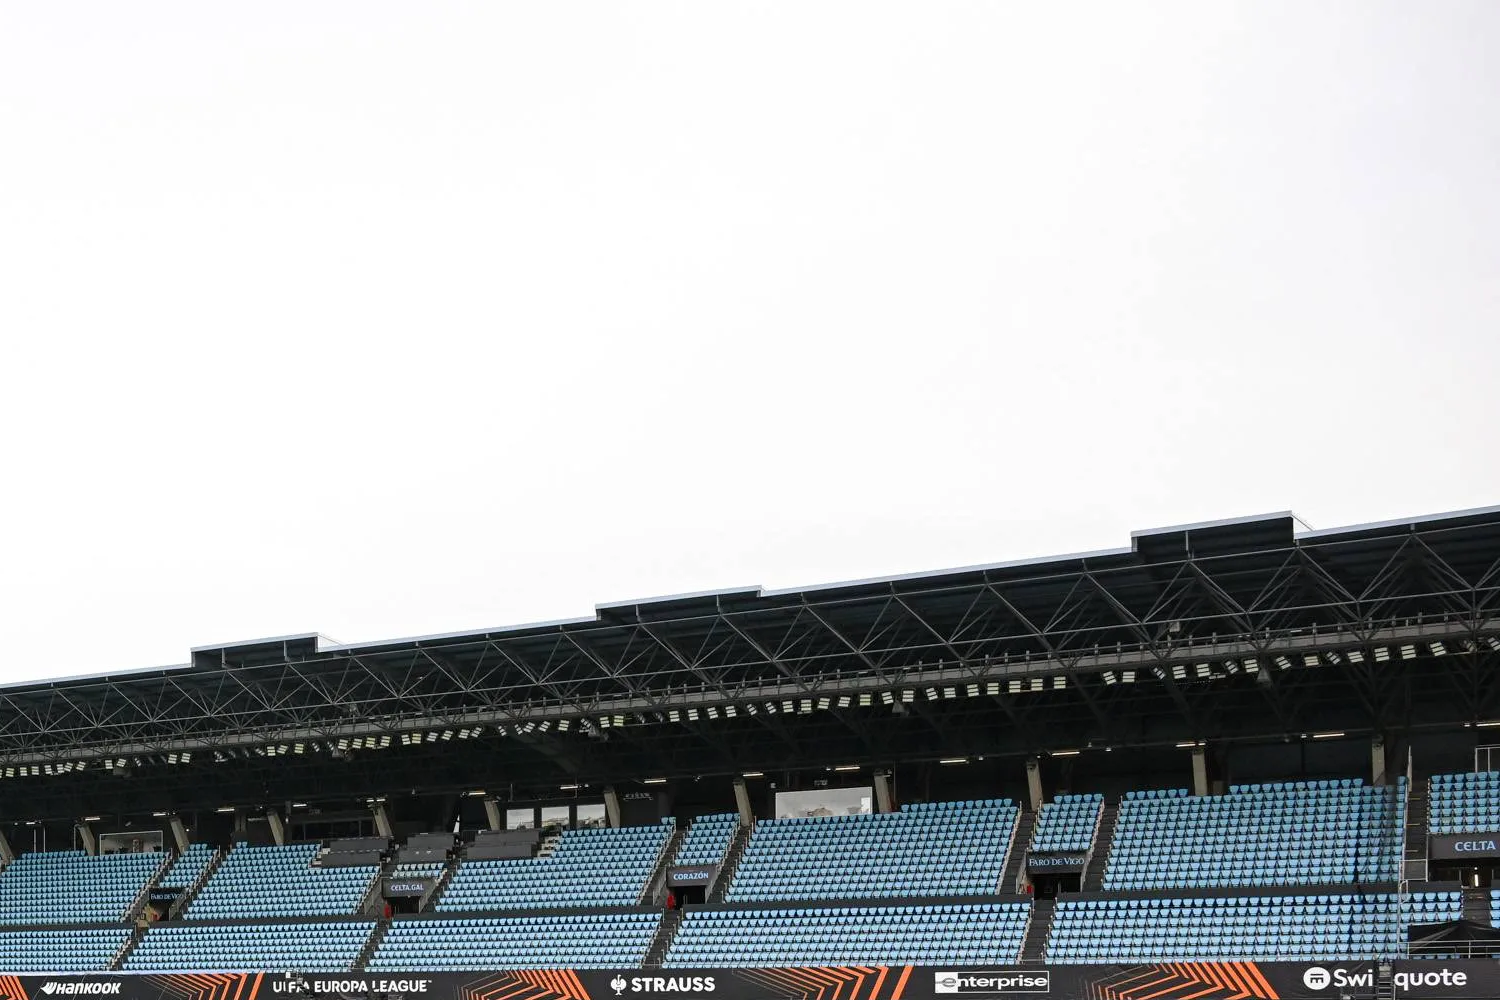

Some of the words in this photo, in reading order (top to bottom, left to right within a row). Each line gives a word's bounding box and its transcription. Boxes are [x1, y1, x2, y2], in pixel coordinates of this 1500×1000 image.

[1454, 840, 1496, 852] CELTA
[1029, 858, 1050, 867] FARO
[1051, 858, 1063, 866] DE
[1064, 857, 1085, 866] VIGO
[673, 871, 709, 880] CORAZÓN
[631, 977, 716, 992] STRAUSS
[940, 975, 1048, 990] enterprise
[1333, 968, 1467, 991] Swiquote
[314, 981, 368, 993] EUROPA
[372, 980, 428, 993] LEAGUE
